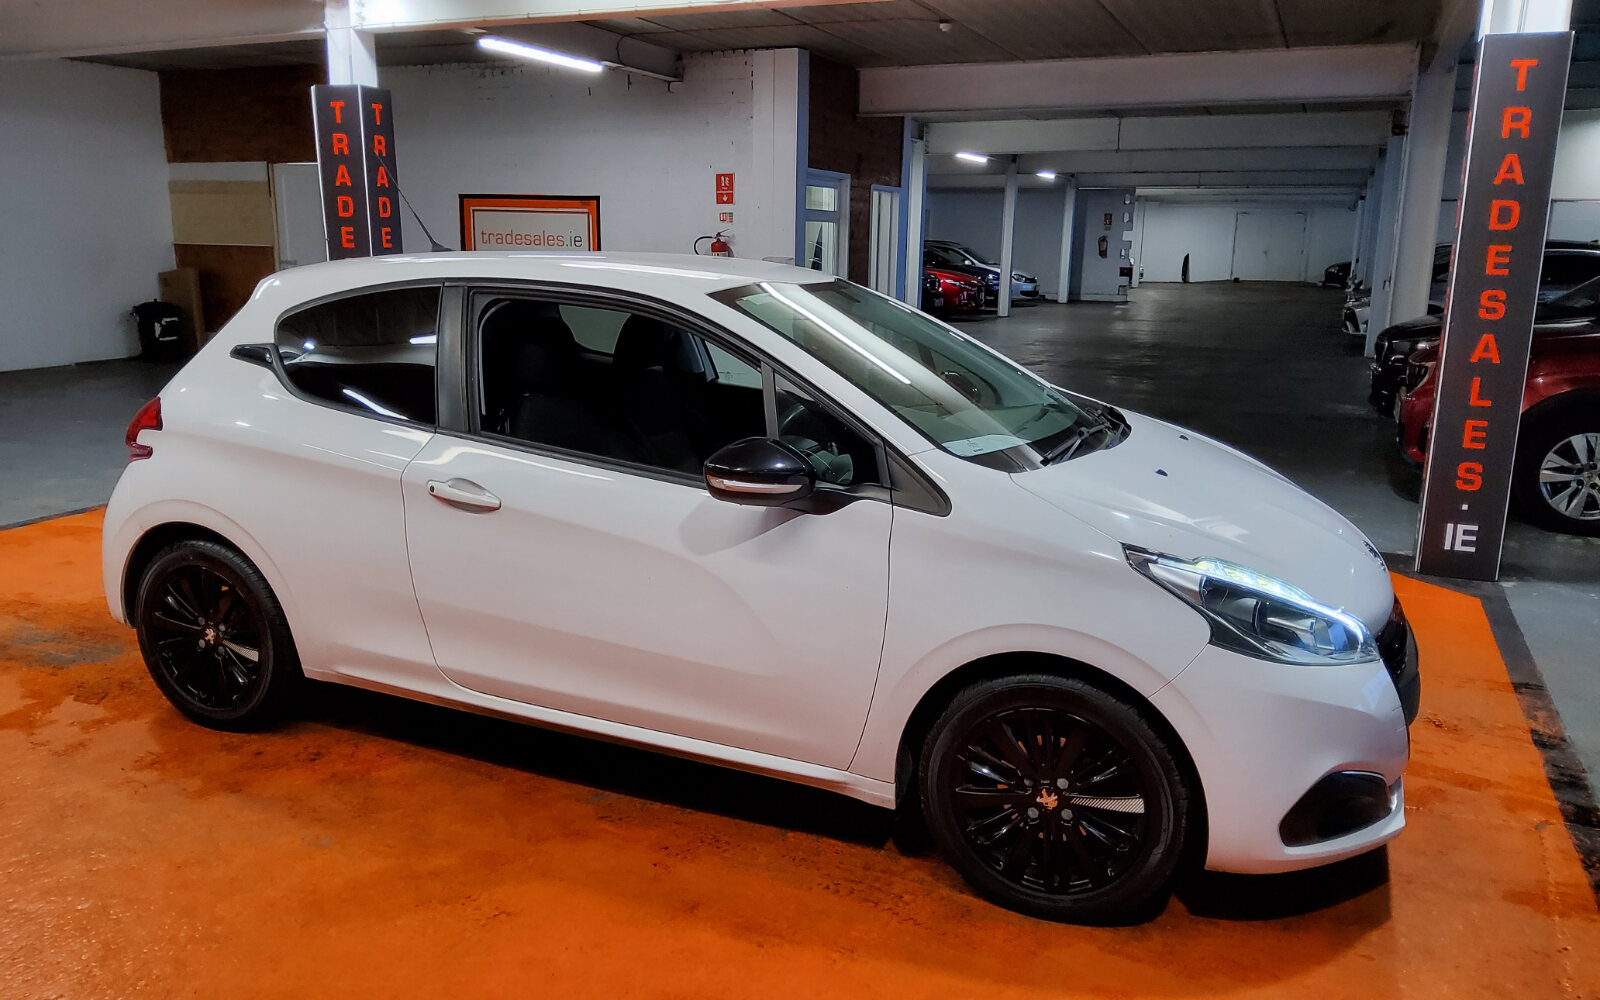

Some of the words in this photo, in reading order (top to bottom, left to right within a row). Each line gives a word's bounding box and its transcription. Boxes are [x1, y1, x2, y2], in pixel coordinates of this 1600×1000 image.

[329, 101, 355, 248] TRADE
[371, 103, 393, 248] TRADE
[480, 229, 583, 248] tradesales.ie
